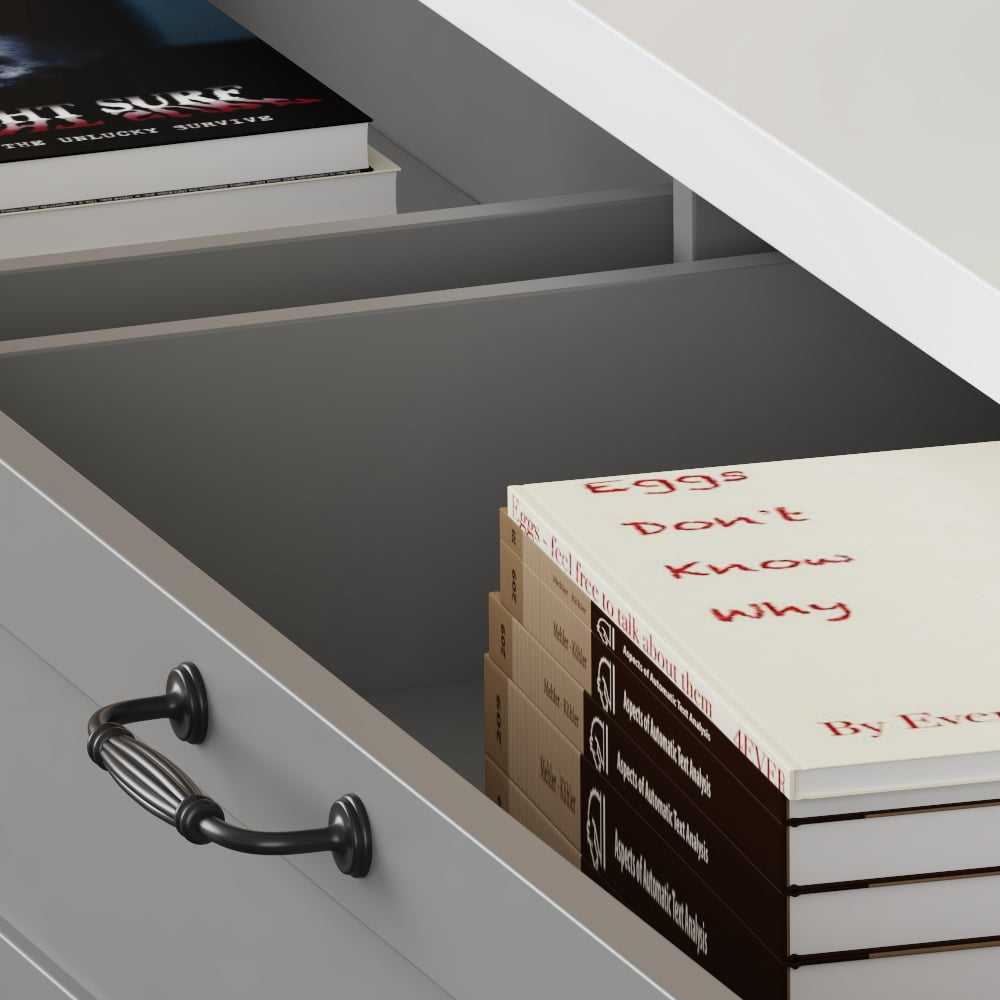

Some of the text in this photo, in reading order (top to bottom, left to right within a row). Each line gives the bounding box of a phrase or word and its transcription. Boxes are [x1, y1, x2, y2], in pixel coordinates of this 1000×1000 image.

[95, 85, 258, 117] SURF
[1, 115, 274, 149] THE UNLUCKY SURVIVE
[584, 471, 749, 495] Eggs
[622, 506, 807, 536] Don't
[664, 555, 854, 580] Know
[511, 495, 540, 542] Eggs
[551, 536, 571, 576] feel
[576, 562, 599, 600] free
[602, 593, 614, 617] to
[617, 609, 640, 645] talk
[642, 633, 678, 683] about
[681, 672, 712, 719] them
[622, 645, 643, 674] Aspects
[676, 700, 689, 720] Text
[623, 689, 643, 727] Aspects
[650, 718, 677, 764] Automatic
[677, 744, 689, 773] Text
[689, 759, 712, 799] Analysis
[819, 719, 885, 738] By
[616, 750, 708, 865] Aspects of Automatic Text Analysis
[614, 827, 708, 956] Aspects of Automatic Text Analysis
